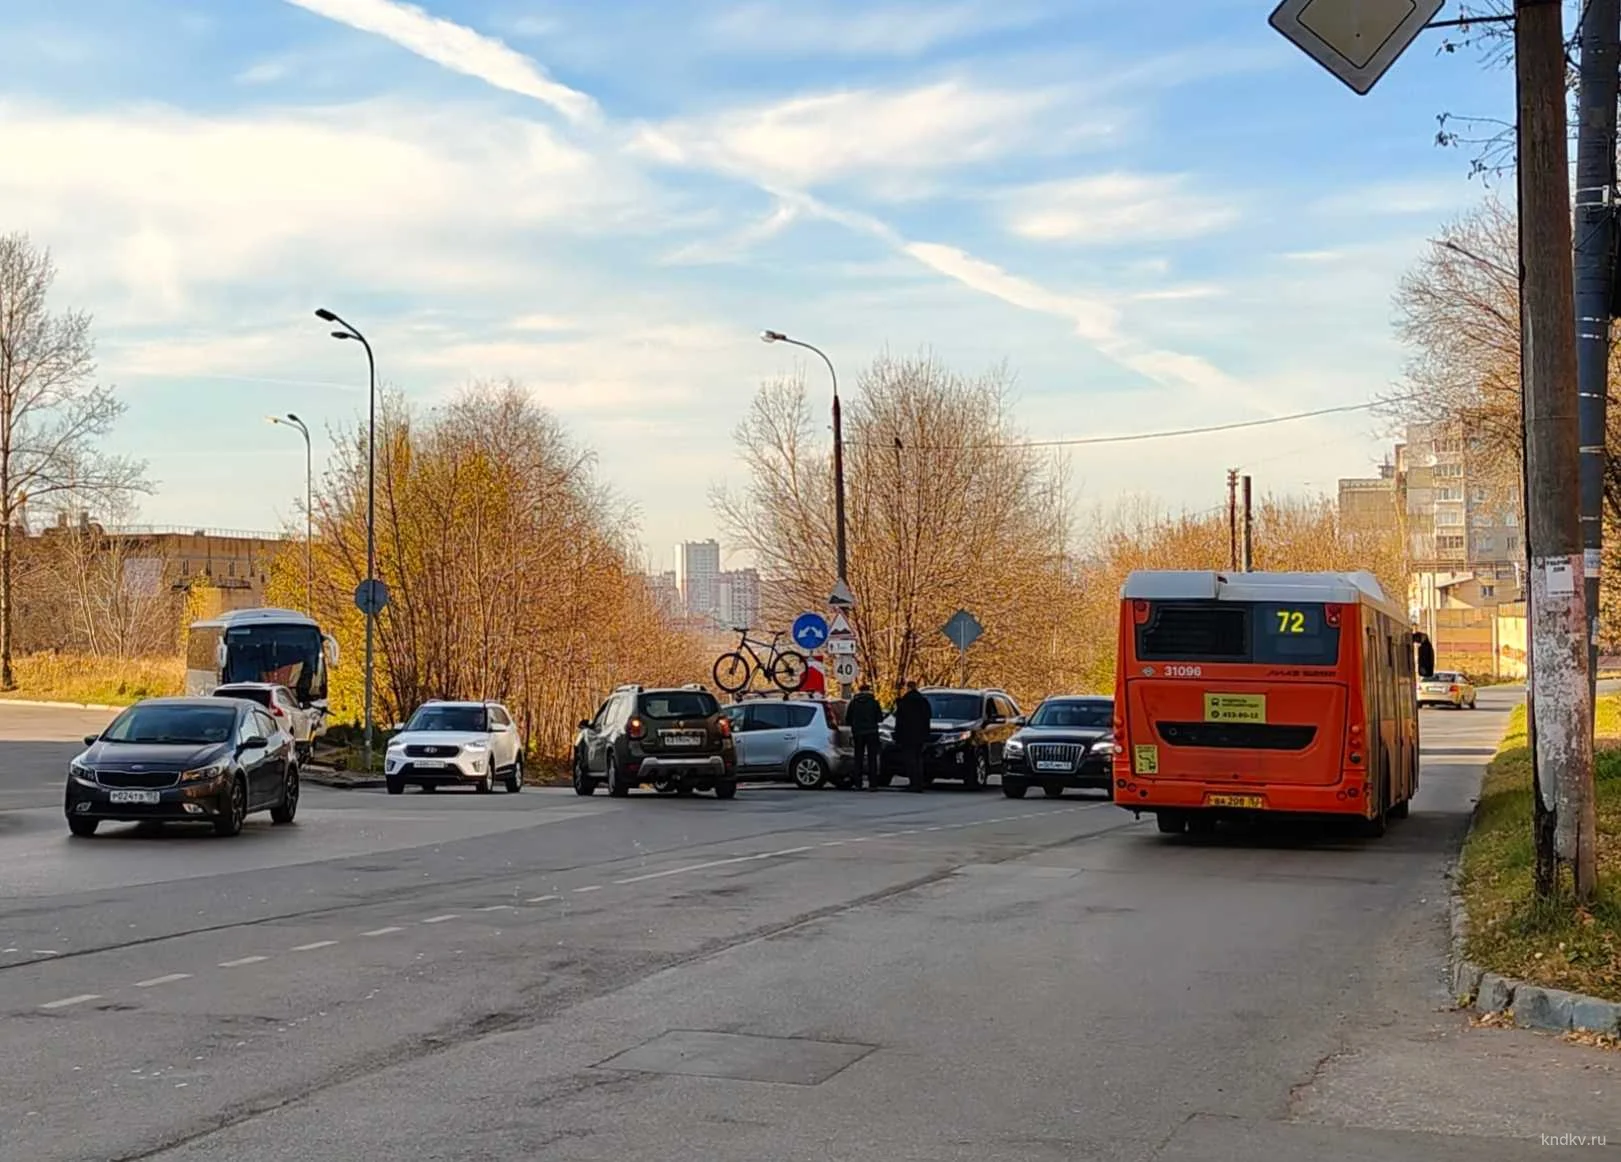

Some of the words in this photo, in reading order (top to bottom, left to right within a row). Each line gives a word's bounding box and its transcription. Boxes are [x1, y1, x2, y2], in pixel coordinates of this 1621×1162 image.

[1276, 611, 1305, 633] 72
[836, 663, 853, 676] 40
[1164, 665, 1201, 677] 31096
